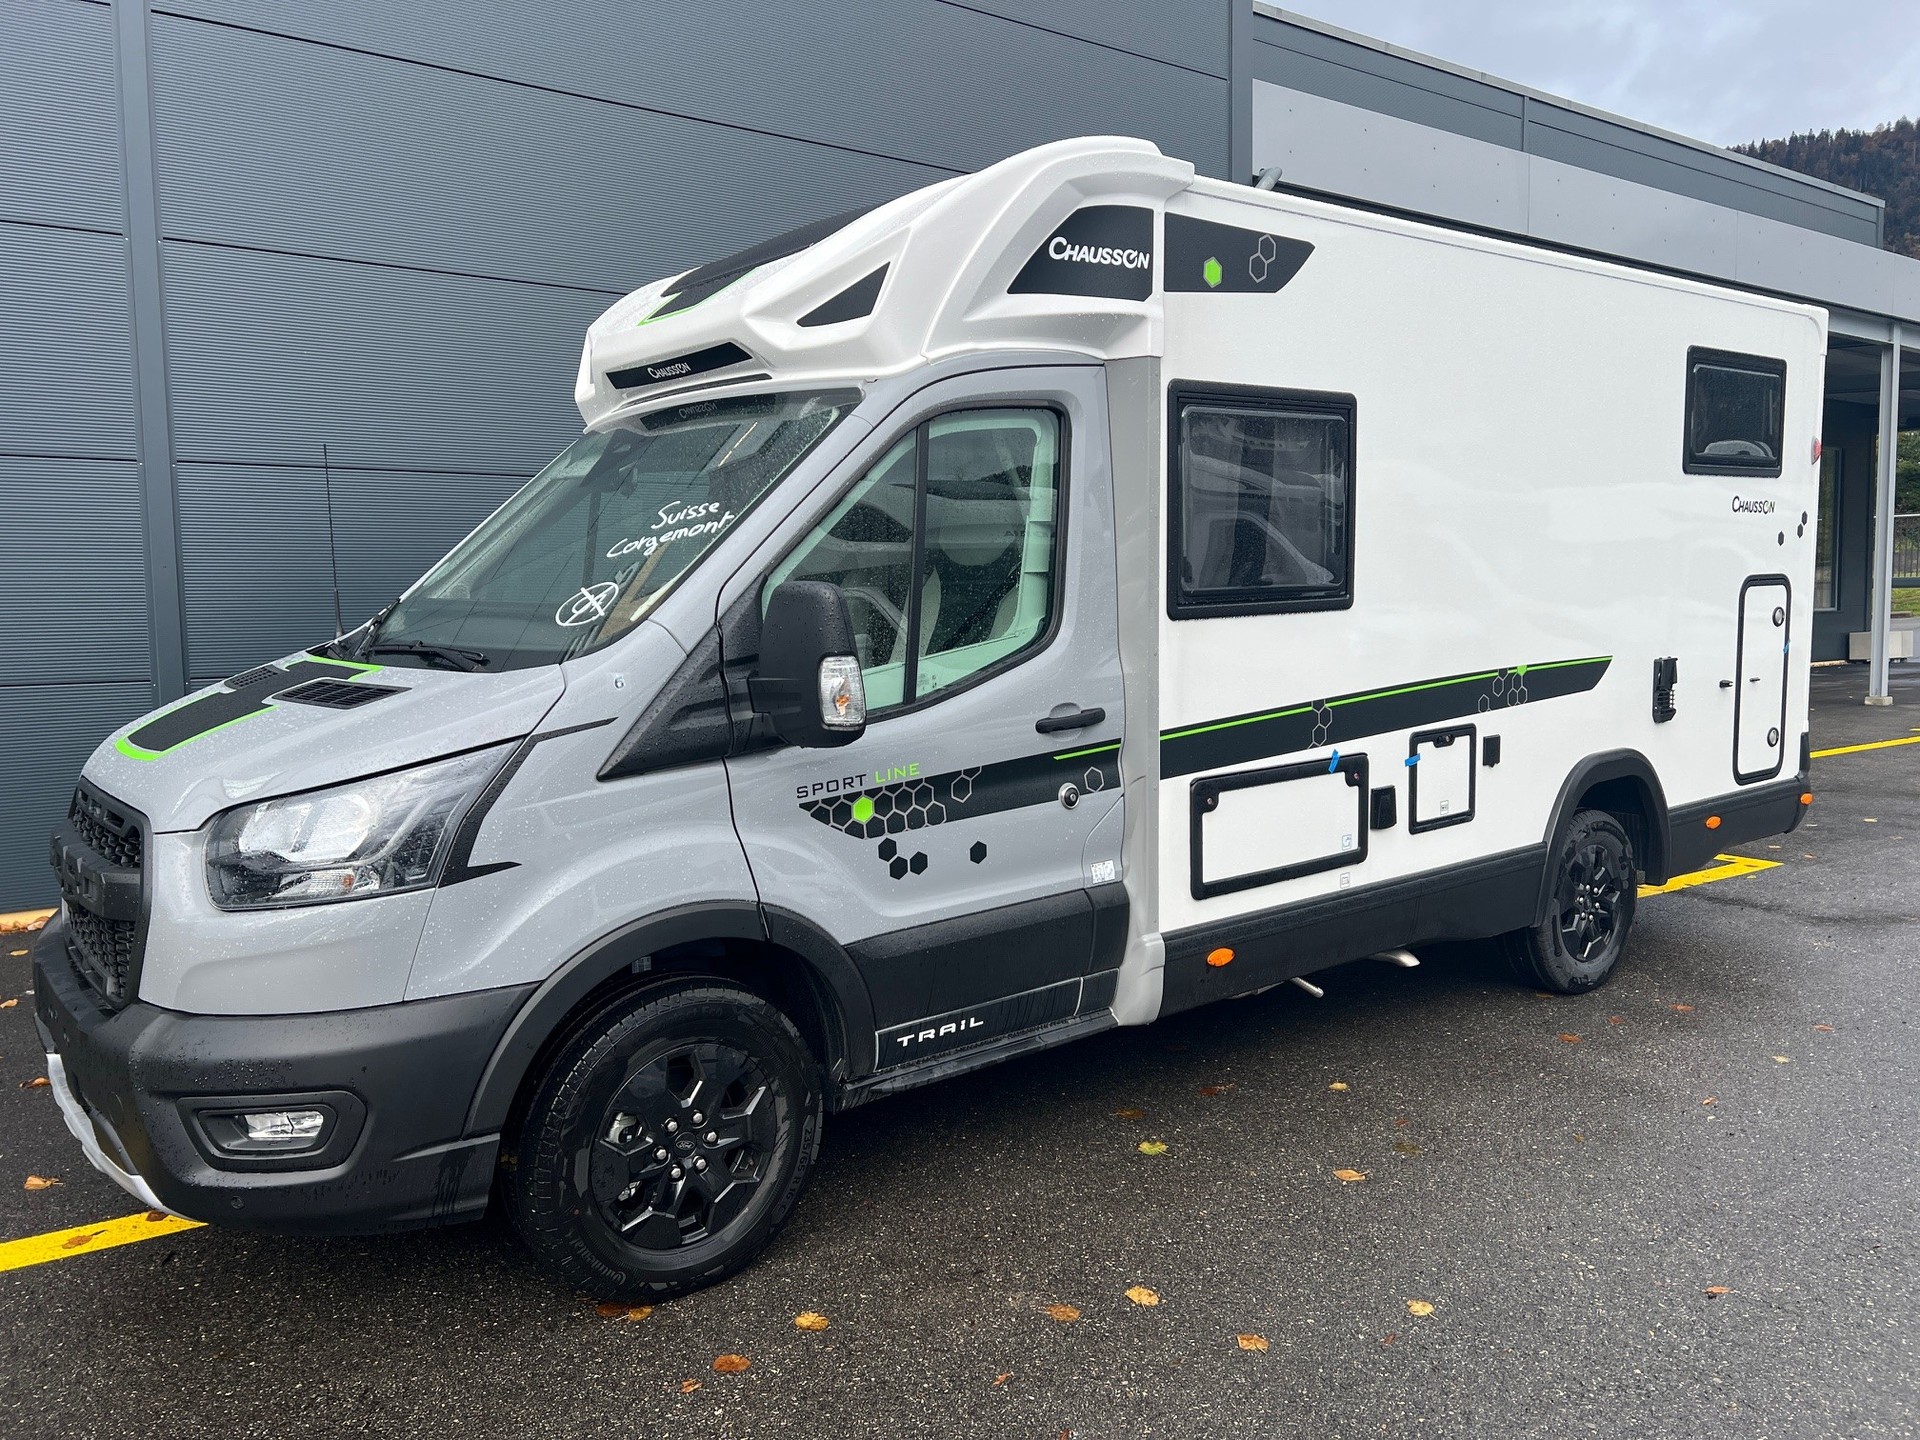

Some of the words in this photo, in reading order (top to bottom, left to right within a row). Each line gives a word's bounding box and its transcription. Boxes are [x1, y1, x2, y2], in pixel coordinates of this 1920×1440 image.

[1048, 236, 1150, 269] CHAUSSON
[647, 362, 691, 379] CHAUSSON
[651, 501, 720, 529] Suisse
[1731, 495, 1776, 515] CHAUSSON
[796, 773, 867, 799] SPORT
[874, 763, 920, 784] LINE
[897, 1016, 984, 1047] TRAIL
